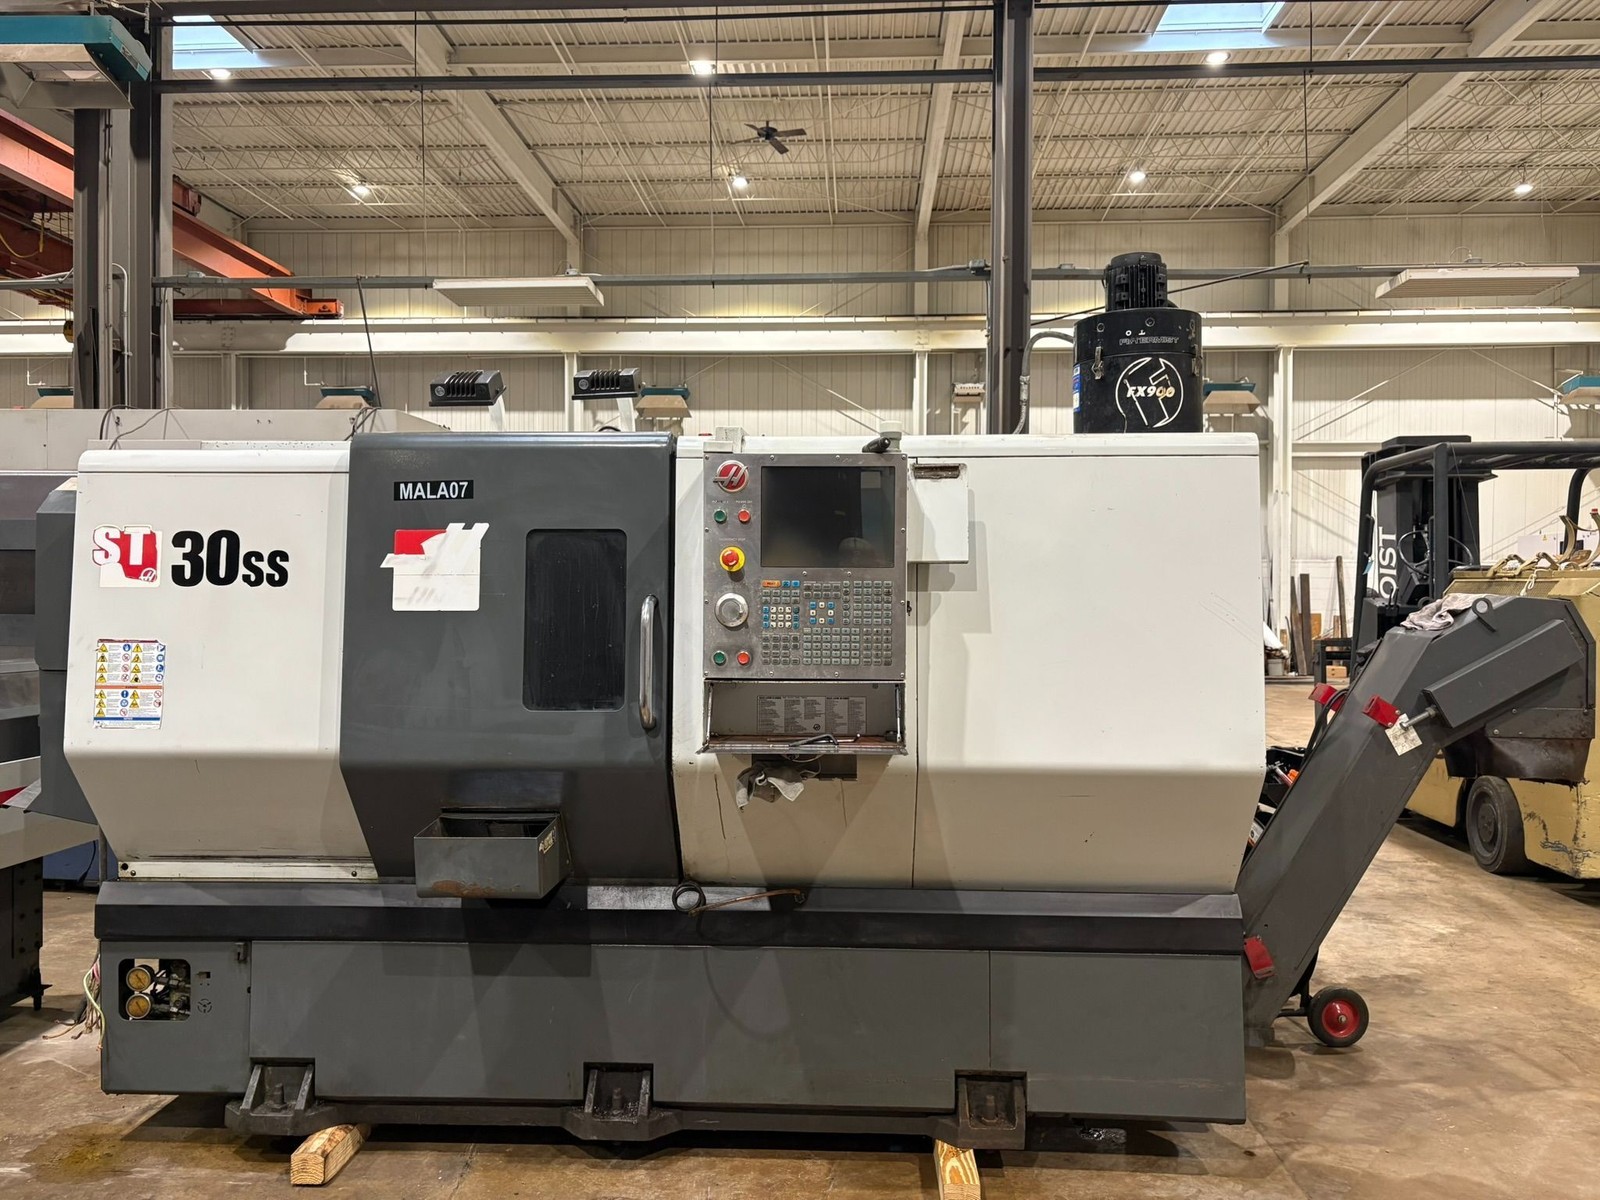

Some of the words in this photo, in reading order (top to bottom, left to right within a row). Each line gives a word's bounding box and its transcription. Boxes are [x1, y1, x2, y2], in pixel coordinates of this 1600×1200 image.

[1126, 385, 1176, 398] FX900
[400, 481, 469, 500] MALA07
[92, 525, 152, 567] ST
